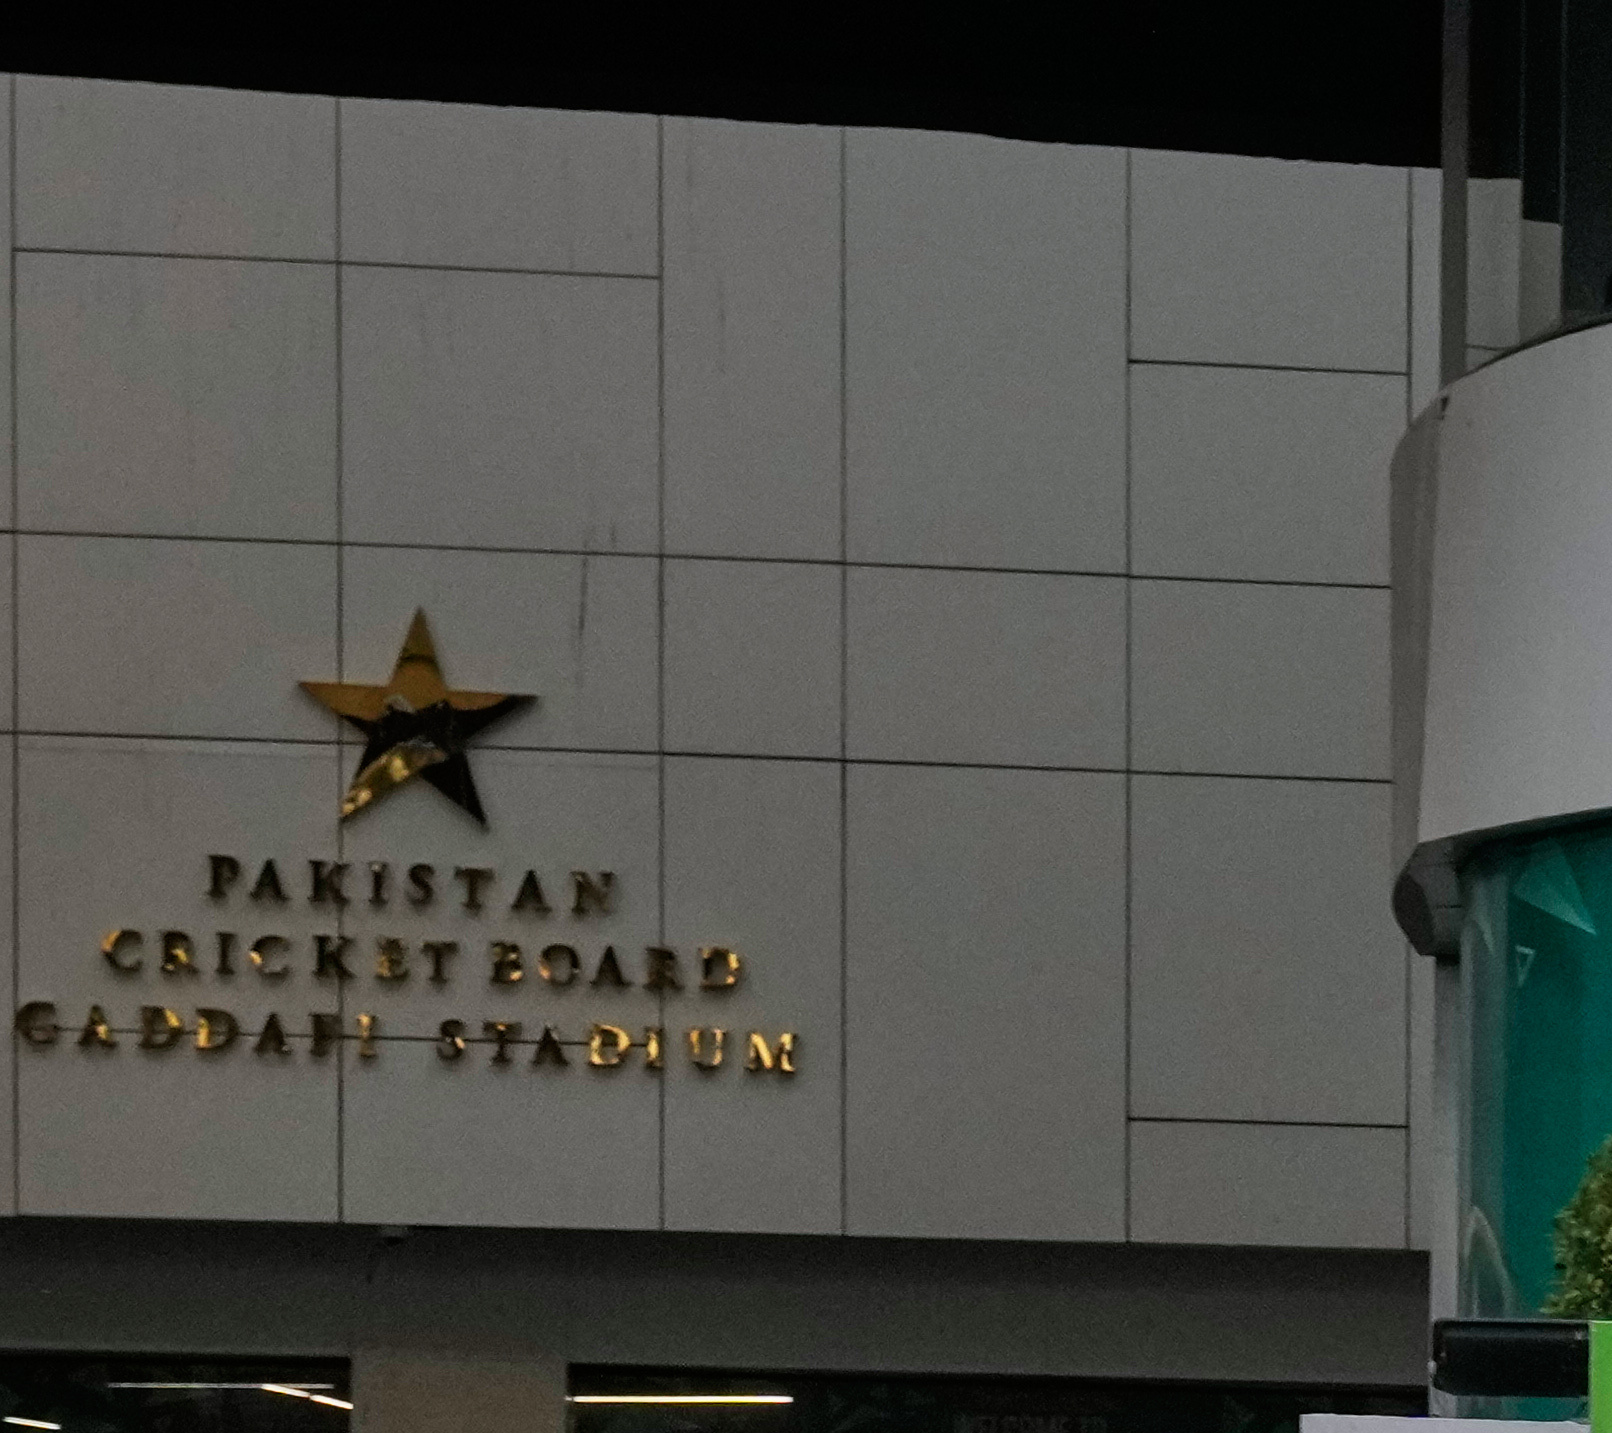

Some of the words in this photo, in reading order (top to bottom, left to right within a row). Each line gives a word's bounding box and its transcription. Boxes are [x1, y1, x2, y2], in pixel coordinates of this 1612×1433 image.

[207, 853, 619, 915] PAKISTAN
[101, 927, 458, 984] CRICKET
[490, 940, 743, 992] BOARD
[13, 999, 381, 1057] GADDAFI
[436, 1015, 799, 1076] STADIUM
